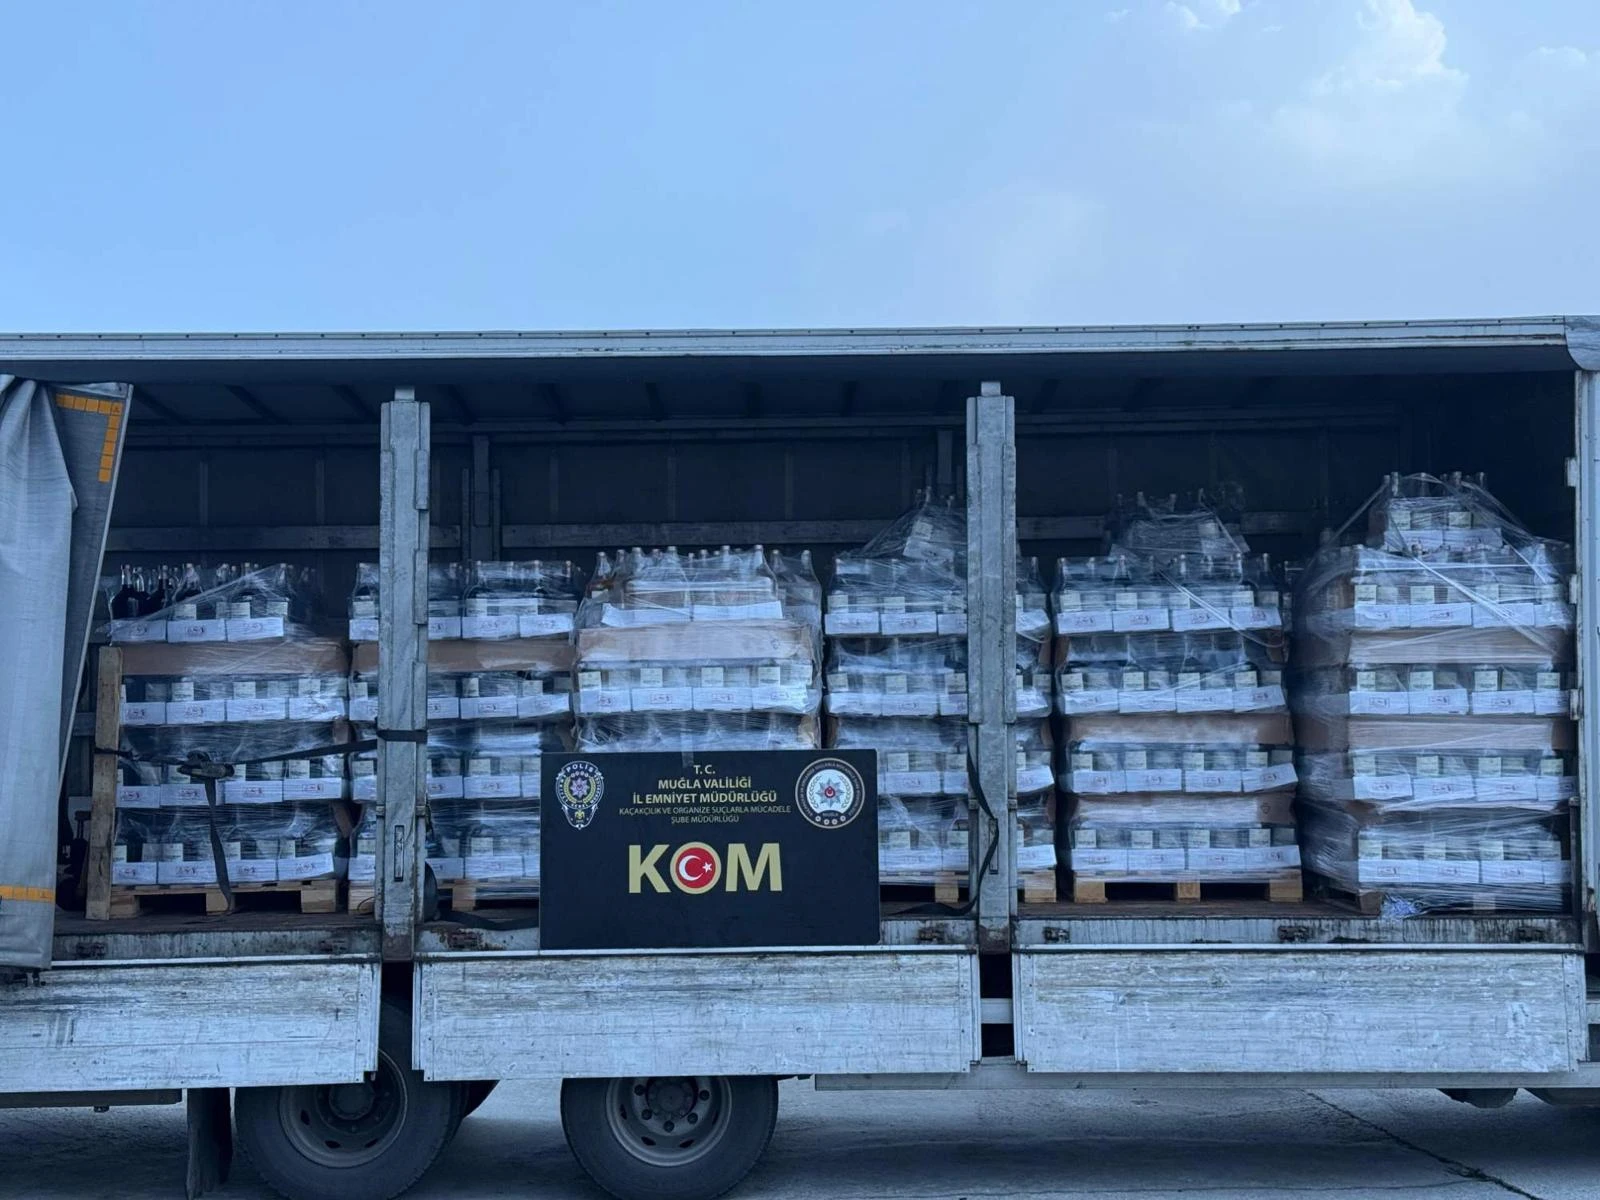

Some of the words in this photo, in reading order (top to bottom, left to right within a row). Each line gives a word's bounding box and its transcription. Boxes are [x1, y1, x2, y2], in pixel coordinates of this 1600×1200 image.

[658, 777, 701, 789] MUĞLA
[703, 776, 751, 789] VALİLİĞİ
[632, 792, 643, 804] İL
[645, 791, 697, 804] EMNİYET
[699, 790, 777, 803] MÜDÜRLÜĞÜ
[619, 807, 661, 816] KAÇAKÇILIK
[672, 806, 710, 814] ORGANİZE
[711, 806, 749, 815] SUÇLARLA
[750, 804, 791, 813] MÜCADELE
[671, 816, 689, 825] ŞUBE
[690, 815, 739, 823] MÜDÜRLÜĞÜ
[628, 841, 783, 895] KOM
